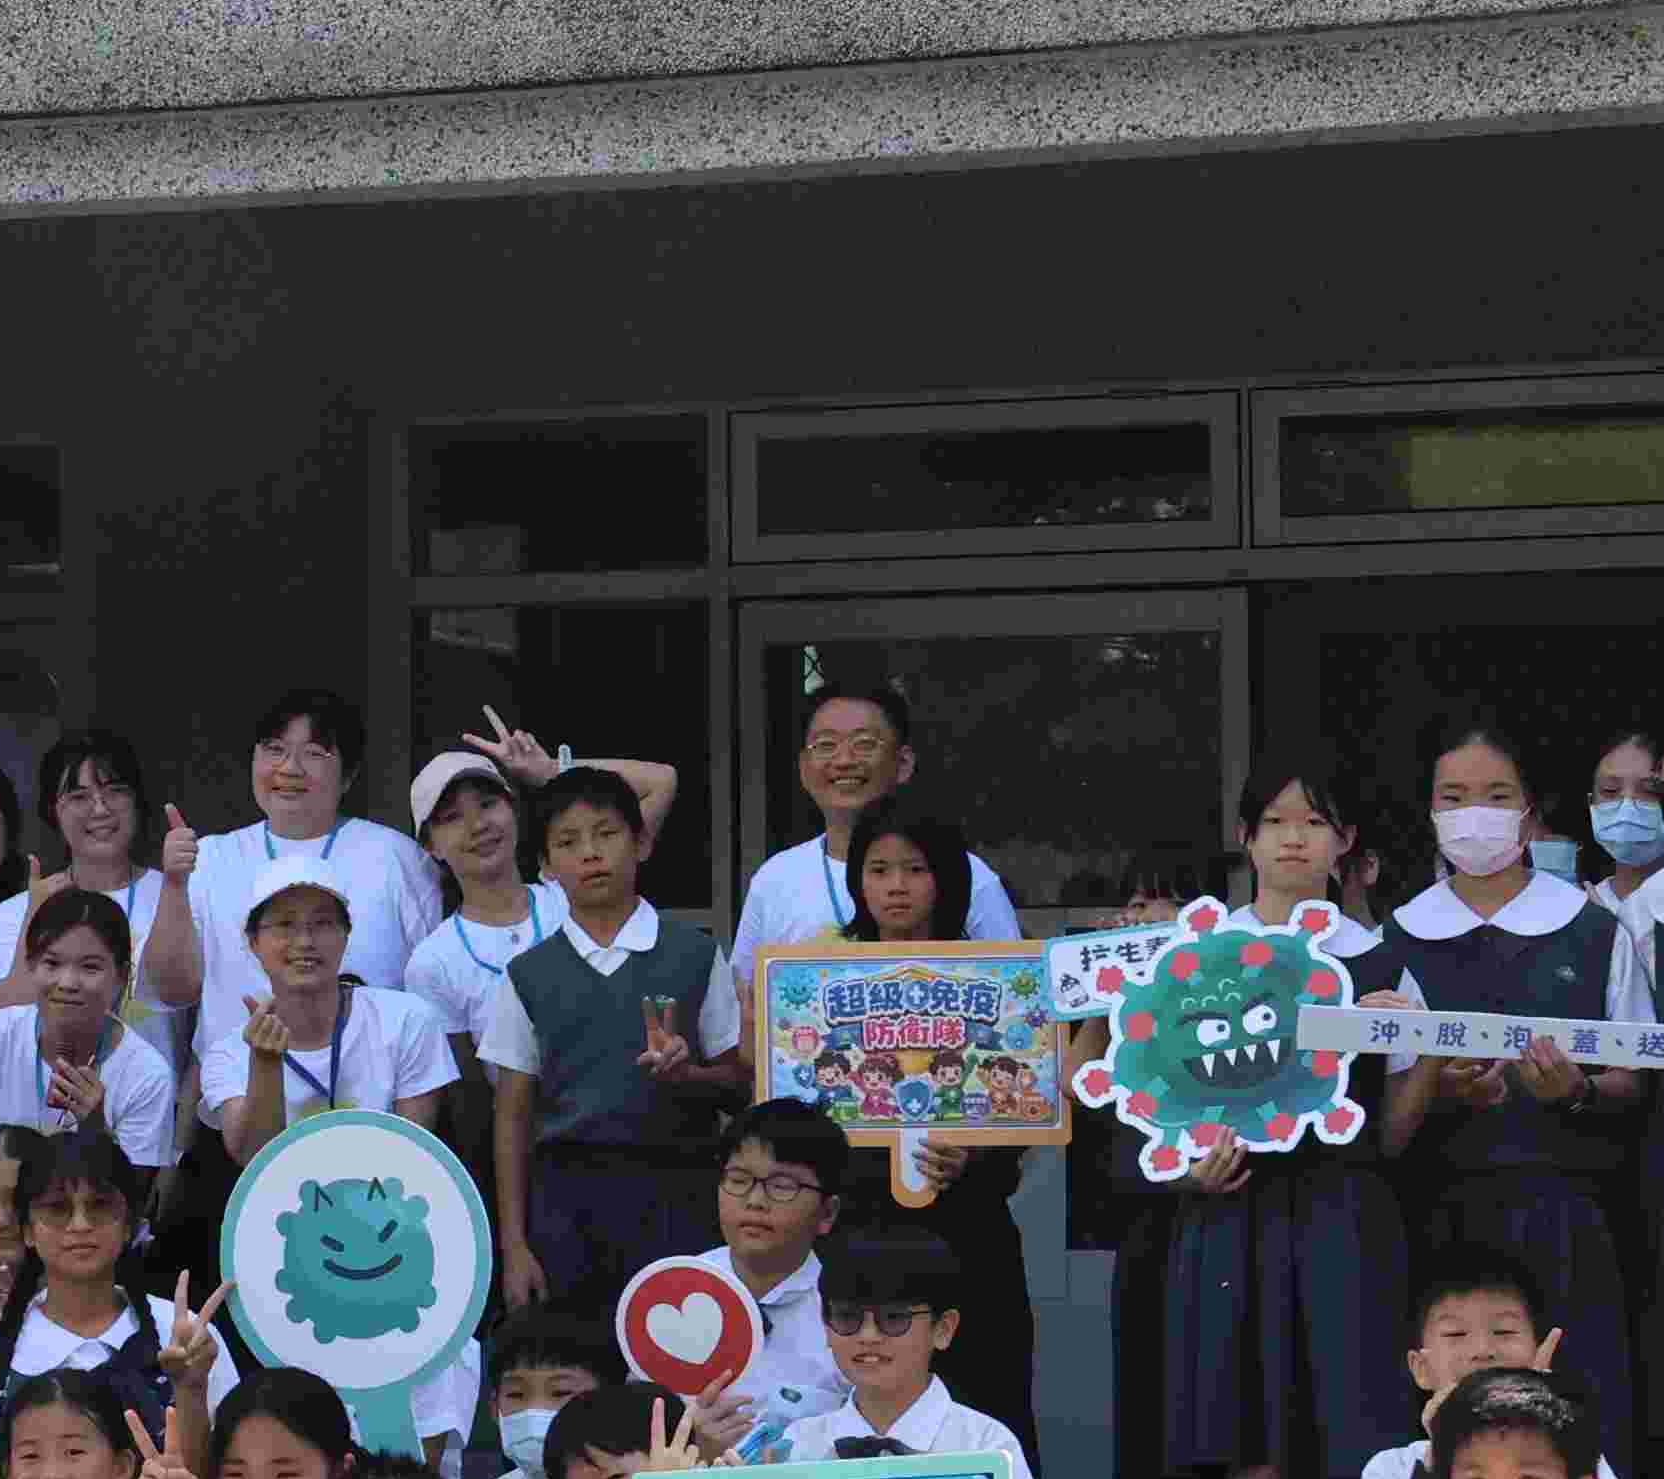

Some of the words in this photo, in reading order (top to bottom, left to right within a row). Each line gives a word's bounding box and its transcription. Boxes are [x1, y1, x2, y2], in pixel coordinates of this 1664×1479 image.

[827, 980, 996, 1018] 超級免疫
[863, 1017, 966, 1048] 防衛隊
